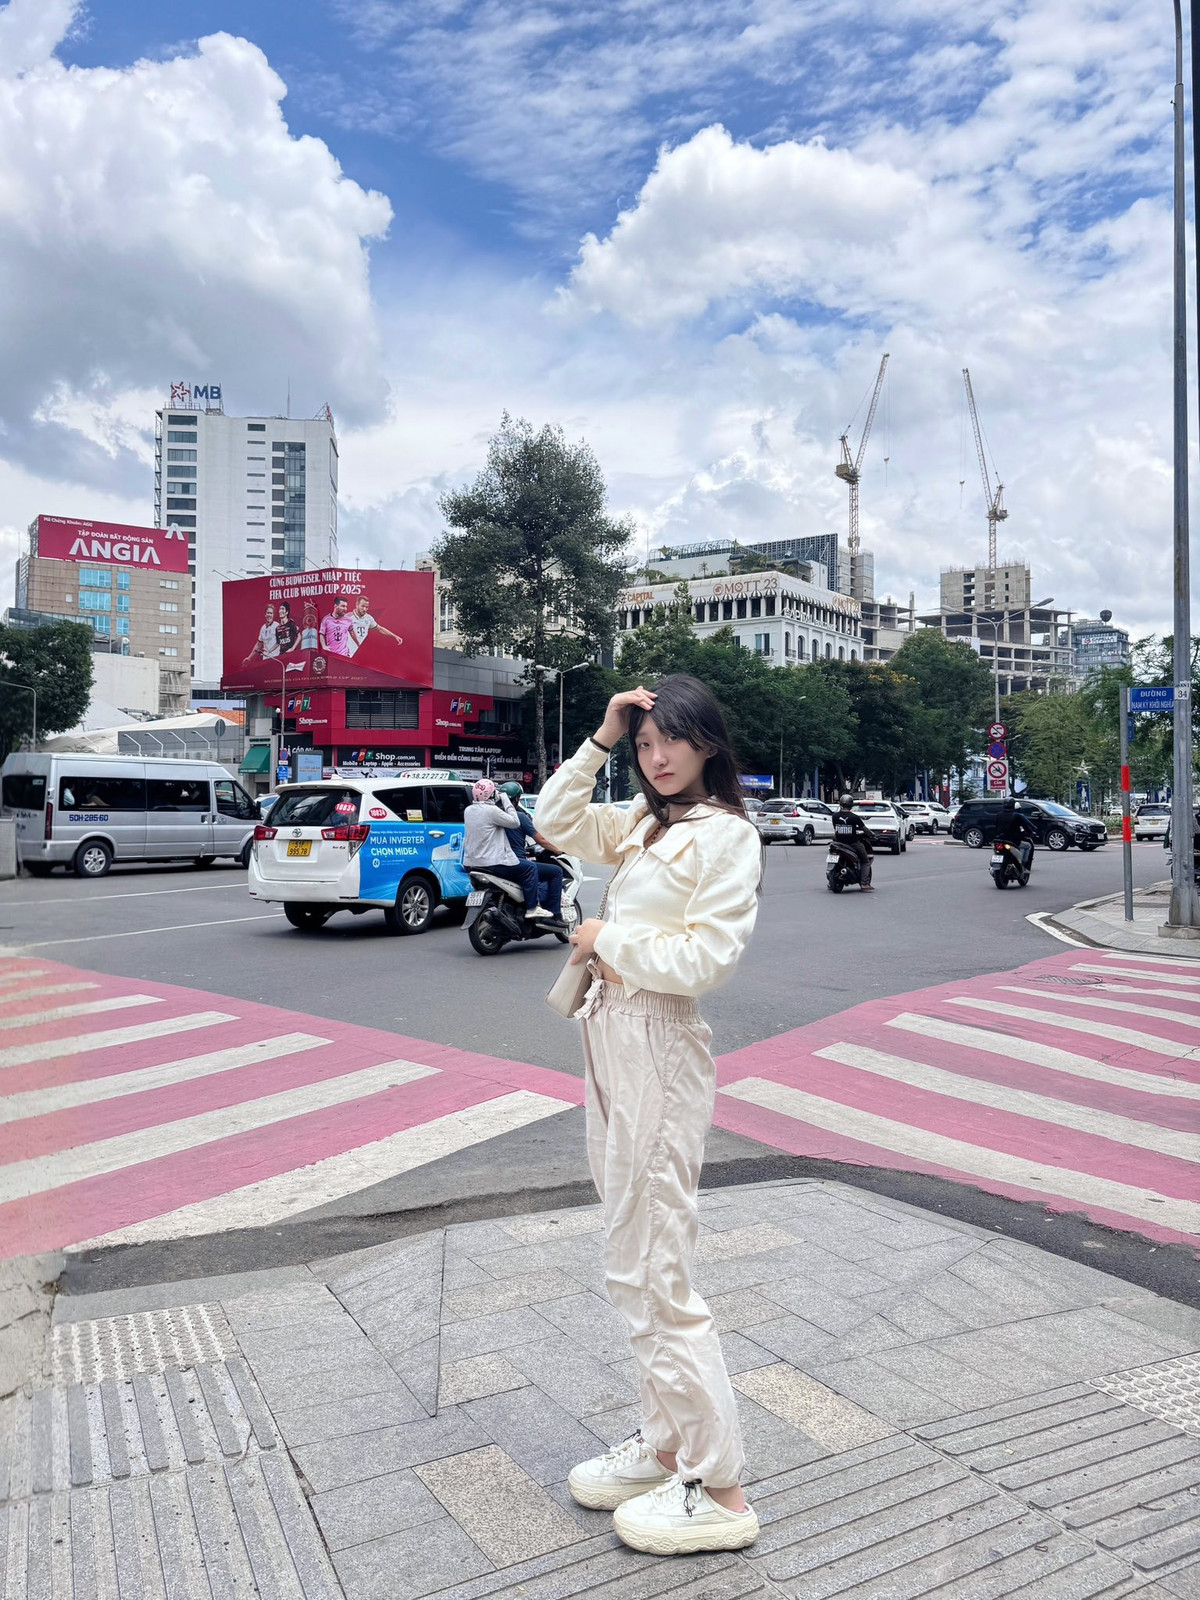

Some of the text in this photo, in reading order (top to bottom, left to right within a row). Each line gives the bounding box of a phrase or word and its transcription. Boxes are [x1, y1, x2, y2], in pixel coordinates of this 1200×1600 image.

[194, 385, 221, 399] MB
[77, 529, 89, 537] TẬP
[109, 532, 122, 540] BẤT
[122, 535, 140, 543] ĐỘNG
[269, 576, 285, 588] CÙNG
[321, 570, 342, 582] NHẬP
[343, 571, 362, 584] TIỆC
[724, 578, 778, 593] MOTT 23
[269, 589, 282, 600] FIFA
[283, 587, 299, 599] CLUB
[300, 584, 324, 597] WORLD
[324, 583, 340, 594] CUP
[627, 591, 654, 602] CAPITAL
[1140, 690, 1167, 698] ĐƯỜNG
[1177, 690, 1188, 698] 34
[287, 694, 312, 713] FPT
[450, 697, 472, 715] FPT
[1132, 701, 1142, 709] NAM
[350, 748, 374, 761] FPT
[457, 753, 471, 762] CÔNG
[335, 803, 356, 812] 10834
[370, 808, 386, 817] 10834
[370, 836, 425, 844] MUA INVERTER
[370, 847, 419, 858] CHỌN MIDEA
